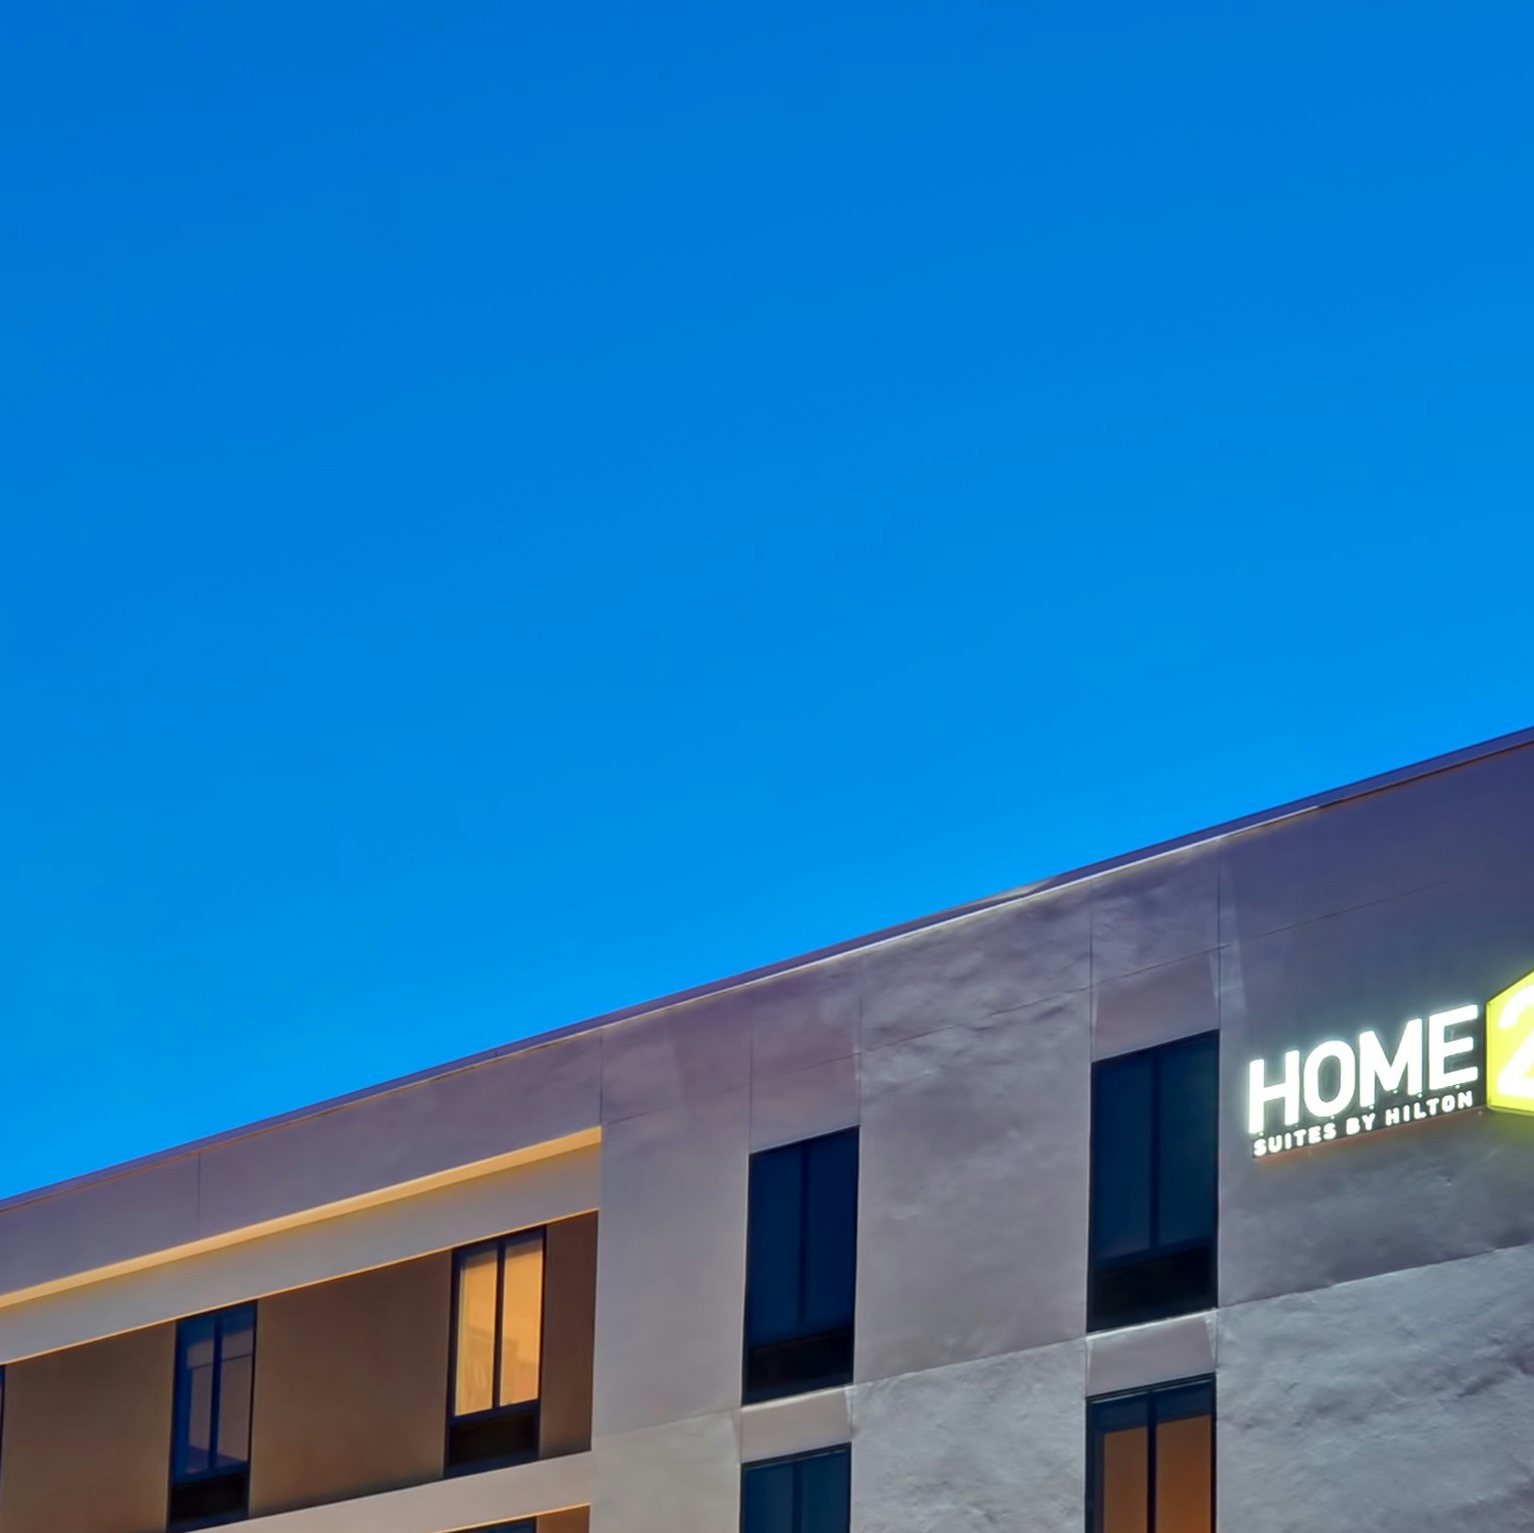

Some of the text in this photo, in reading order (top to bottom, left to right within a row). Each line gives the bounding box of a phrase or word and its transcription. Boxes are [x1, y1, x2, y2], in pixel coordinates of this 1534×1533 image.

[1254, 1091, 1473, 1157] SUITES BY HILTON
